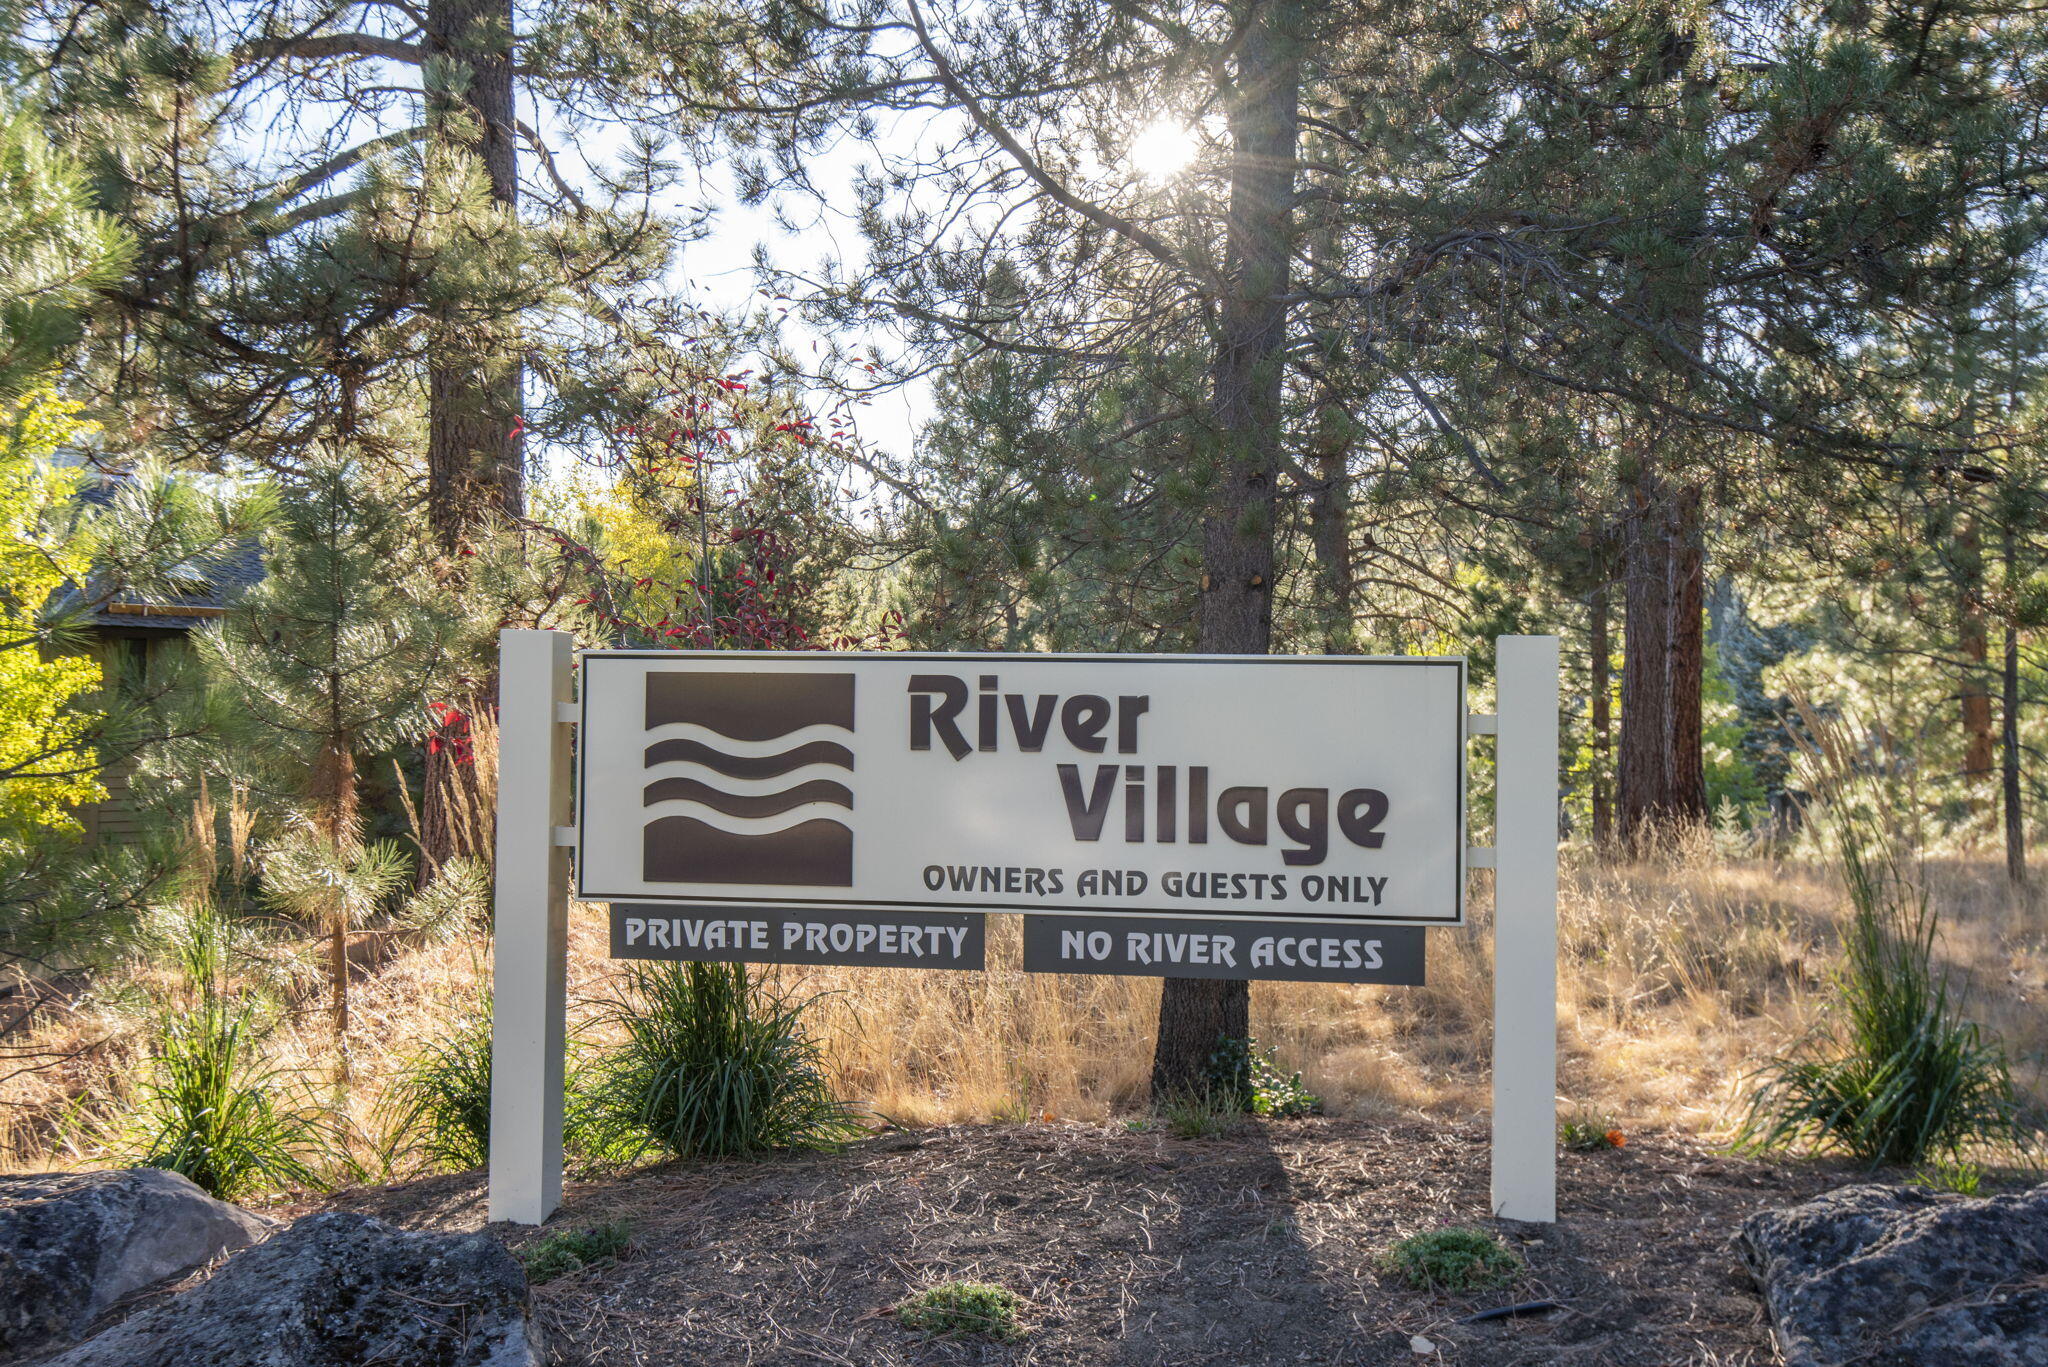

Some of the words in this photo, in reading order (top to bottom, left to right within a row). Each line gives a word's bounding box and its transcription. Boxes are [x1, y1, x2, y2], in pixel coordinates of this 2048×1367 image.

[907, 674, 1150, 762] River
[1055, 763, 1390, 867] Village
[923, 864, 1064, 897] OWNERS
[1076, 869, 1149, 898] AND
[1161, 871, 1288, 901] GUESTS
[1300, 874, 1389, 907] ONLY
[625, 917, 769, 951] PRIVATE
[782, 922, 969, 959] PROPERTY
[1061, 930, 1113, 961] NO
[1127, 932, 1237, 968] RIVER
[1250, 936, 1383, 969] ACCESS
